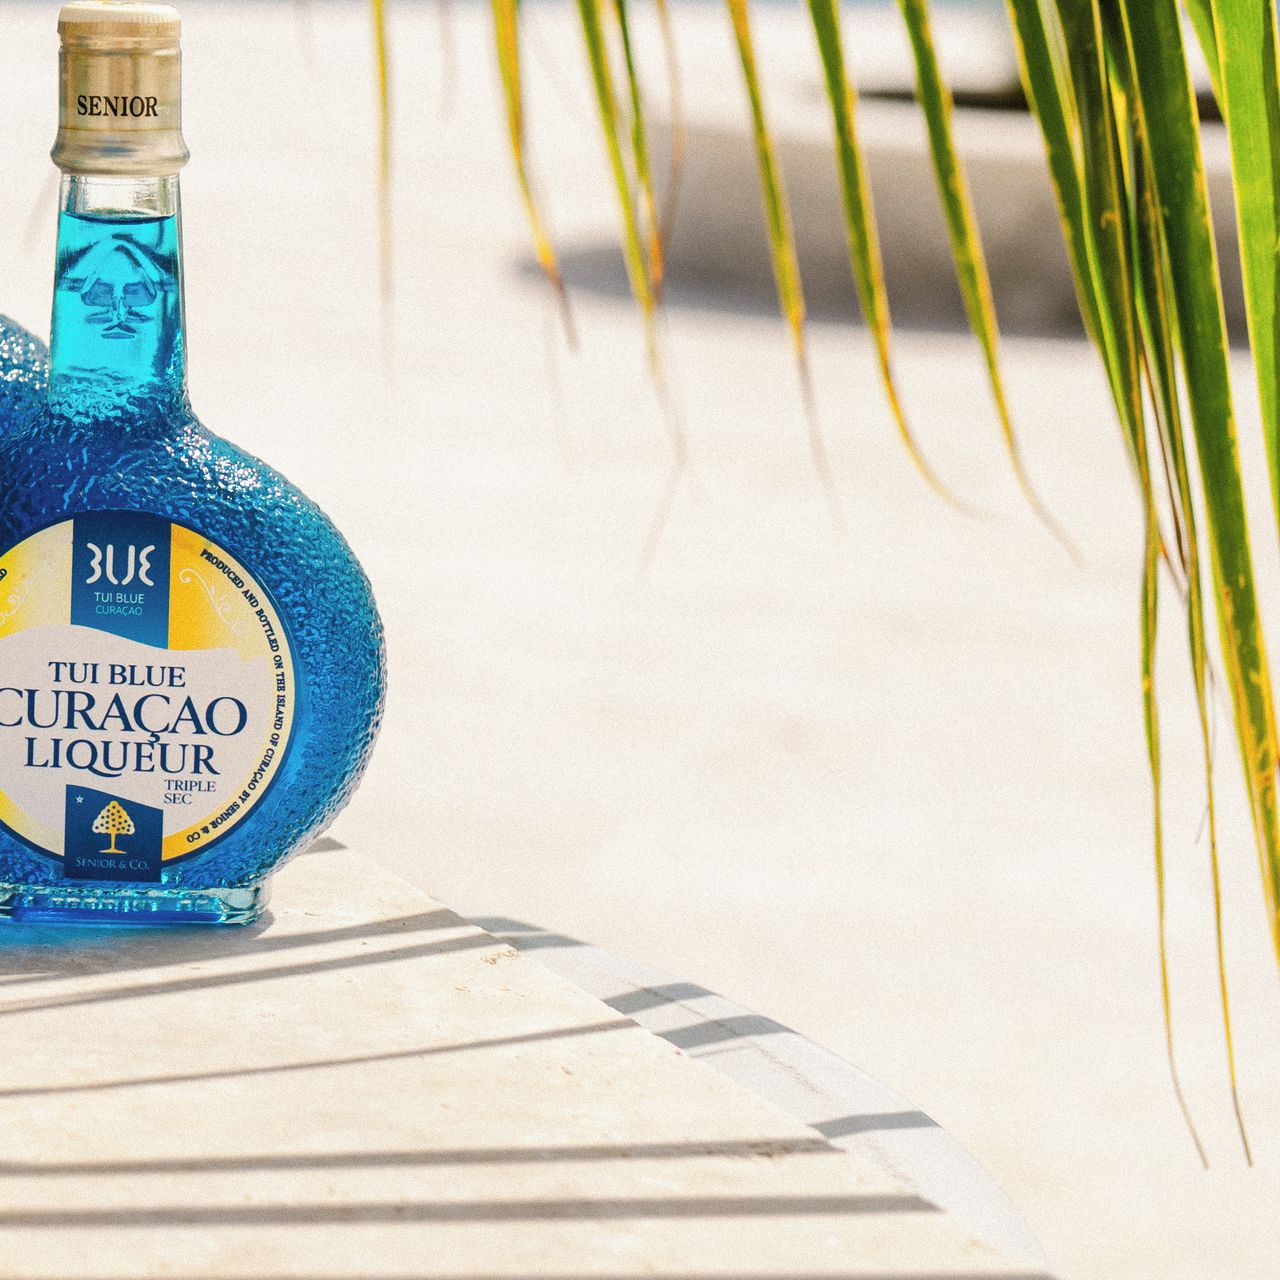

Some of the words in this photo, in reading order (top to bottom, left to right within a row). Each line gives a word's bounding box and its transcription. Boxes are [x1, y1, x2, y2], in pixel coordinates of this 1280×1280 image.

[77, 95, 158, 117] SENIOR
[200, 548, 245, 589] PRODUCED
[94, 592, 112, 602] TUI
[116, 593, 145, 604] BLUE
[242, 589, 259, 608] AND
[96, 605, 143, 616] CURAÇAO
[255, 608, 280, 652] BOTTLED
[273, 654, 284, 669] ON
[48, 661, 99, 684] TUI
[108, 664, 186, 687] BLUE
[276, 671, 285, 692] THE
[273, 694, 286, 730] ISLAND
[268, 732, 280, 747] OF
[24, 737, 221, 778] LIQUEUR
[248, 748, 275, 790] CURAÇAO
[164, 779, 216, 793] TRIPLE
[238, 788, 250, 804] BY
[163, 793, 192, 805] SEC
[209, 801, 240, 830] SENIOR
[186, 831, 201, 843] CO
